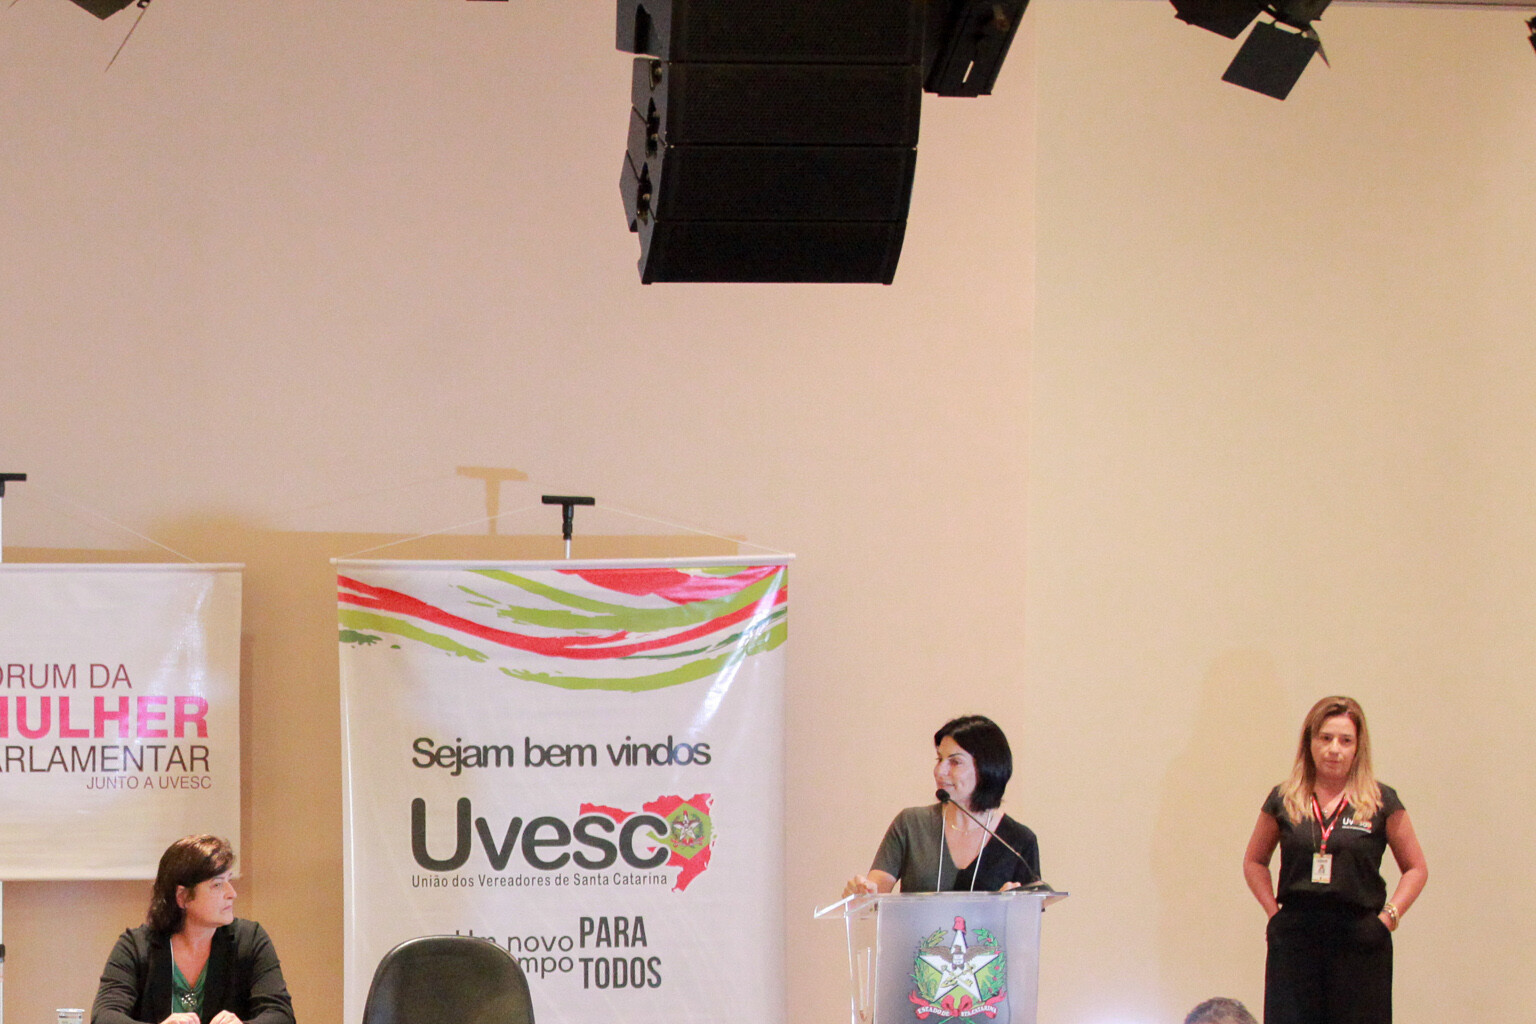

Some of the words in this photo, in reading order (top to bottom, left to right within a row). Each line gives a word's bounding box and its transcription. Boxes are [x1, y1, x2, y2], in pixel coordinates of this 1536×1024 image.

[89, 663, 133, 690] DA
[412, 737, 514, 776] Sejam
[524, 736, 597, 768] bem
[606, 735, 712, 767] vindos
[86, 776, 140, 790] JUNTO
[143, 776, 154, 790] A
[158, 775, 213, 790] UVESC
[411, 796, 670, 872] Uvesc
[411, 874, 449, 888] União
[452, 874, 474, 888] dos
[478, 873, 552, 888] Vereadores
[554, 873, 570, 887] de
[573, 873, 610, 887] Santa
[613, 872, 668, 886] Catarina
[507, 935, 575, 953] novo
[579, 915, 648, 948] PARA
[579, 956, 663, 990] TODOS
